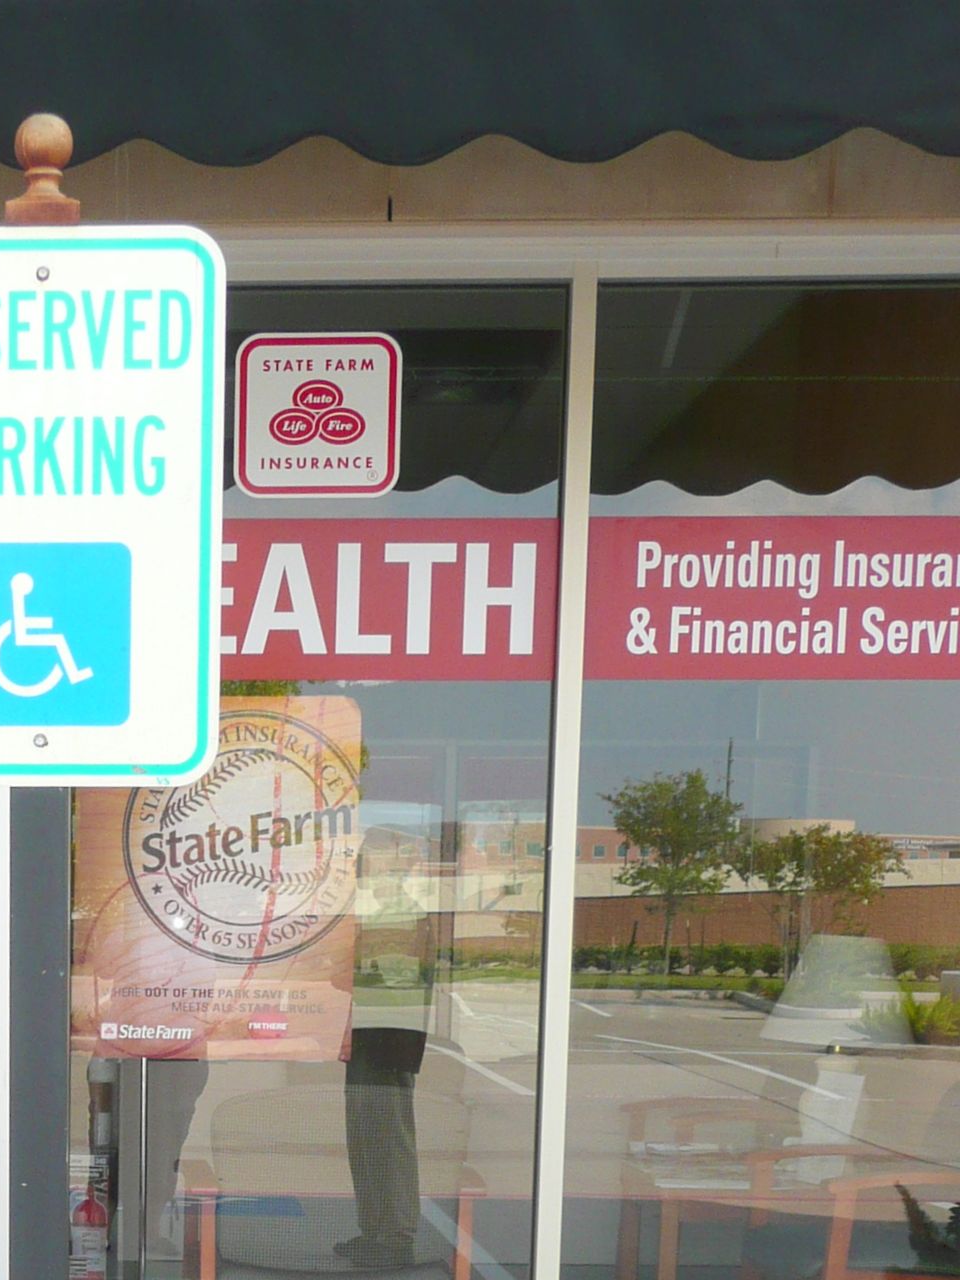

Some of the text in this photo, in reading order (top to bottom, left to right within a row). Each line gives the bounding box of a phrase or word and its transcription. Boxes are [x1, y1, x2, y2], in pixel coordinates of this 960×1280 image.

[262, 358, 375, 372] STATE FARM
[303, 393, 333, 404] Auto
[282, 420, 354, 435] Life Fire
[260, 456, 373, 470] INSURANCE
[636, 540, 960, 599] Providing Insura
[626, 607, 658, 655] &
[669, 606, 848, 654] Financial
[211, 930, 233, 947] 65
[104, 986, 141, 998] HERE
[144, 986, 169, 998] OUT
[172, 986, 189, 998] OF
[191, 987, 215, 999] THE
[218, 988, 250, 999] PARK
[171, 1001, 209, 1013] MEETS
